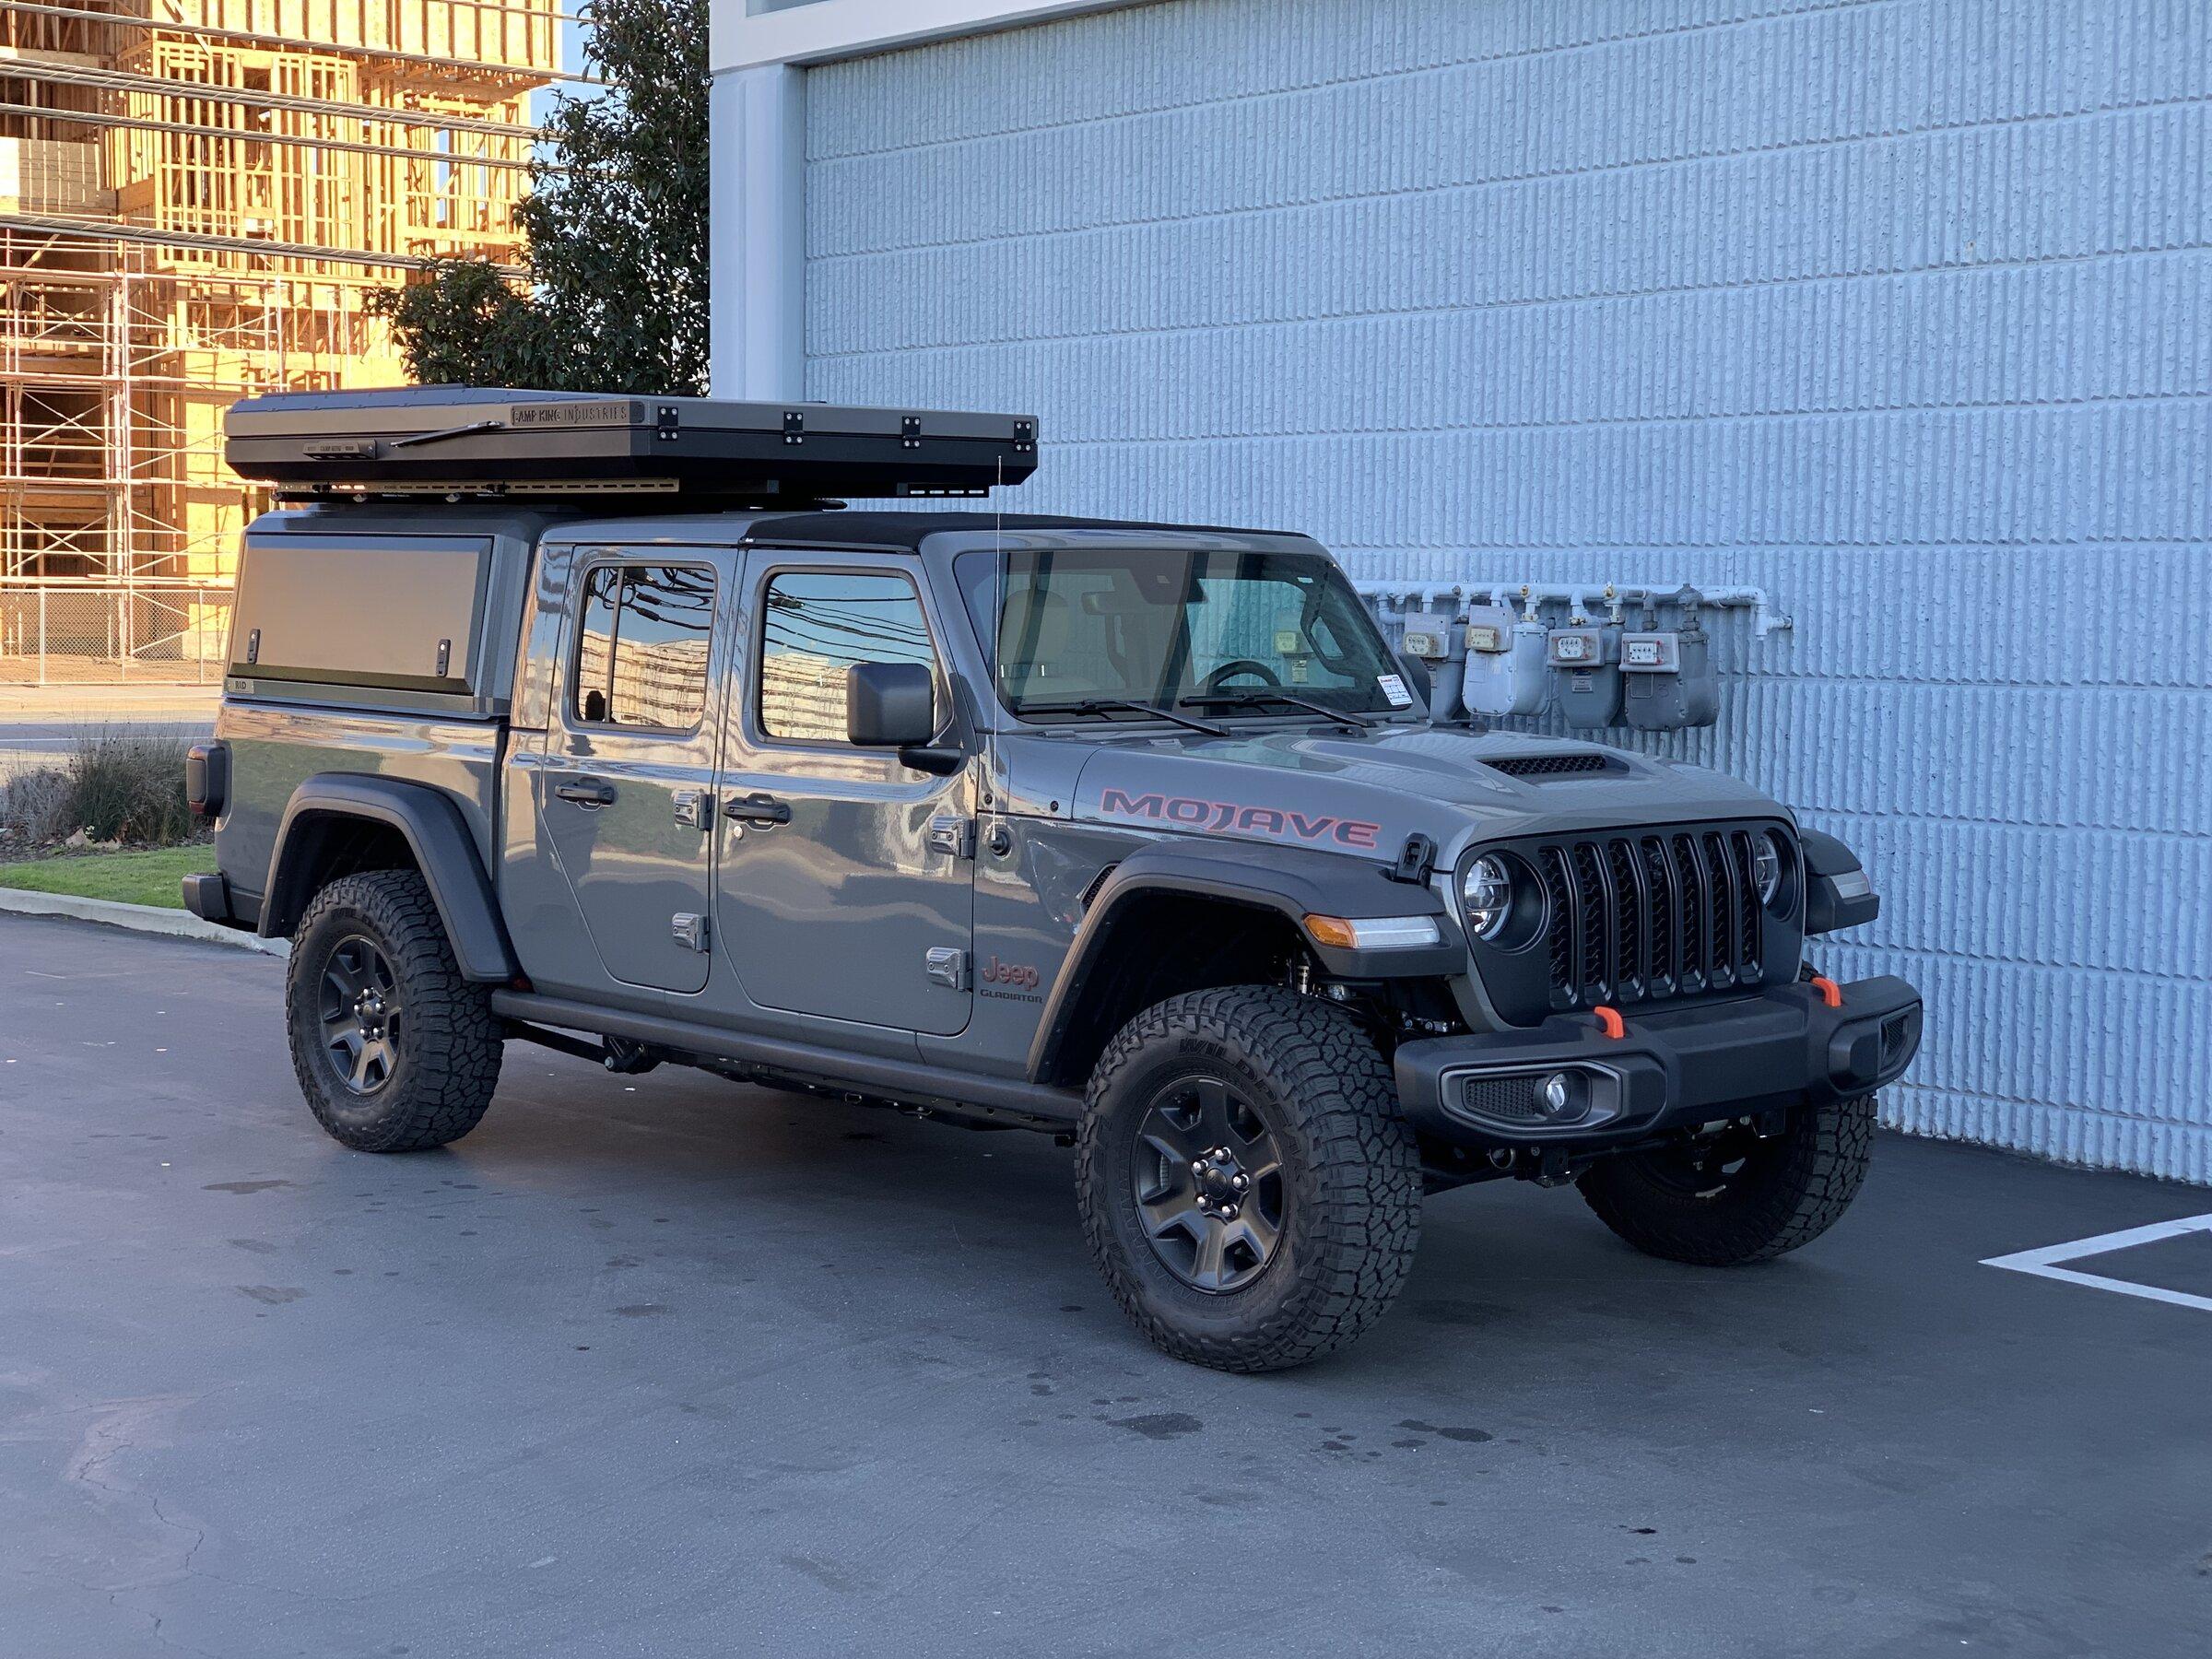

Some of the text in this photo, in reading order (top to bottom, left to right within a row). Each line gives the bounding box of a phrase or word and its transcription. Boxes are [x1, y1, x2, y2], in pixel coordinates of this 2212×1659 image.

[512, 406, 627, 423] CAMP KING INDUSTRIES
[1101, 788, 1381, 849] MOJAVE
[982, 956, 1039, 991] Jeep
[980, 989, 1042, 1004] GLADIATOR
